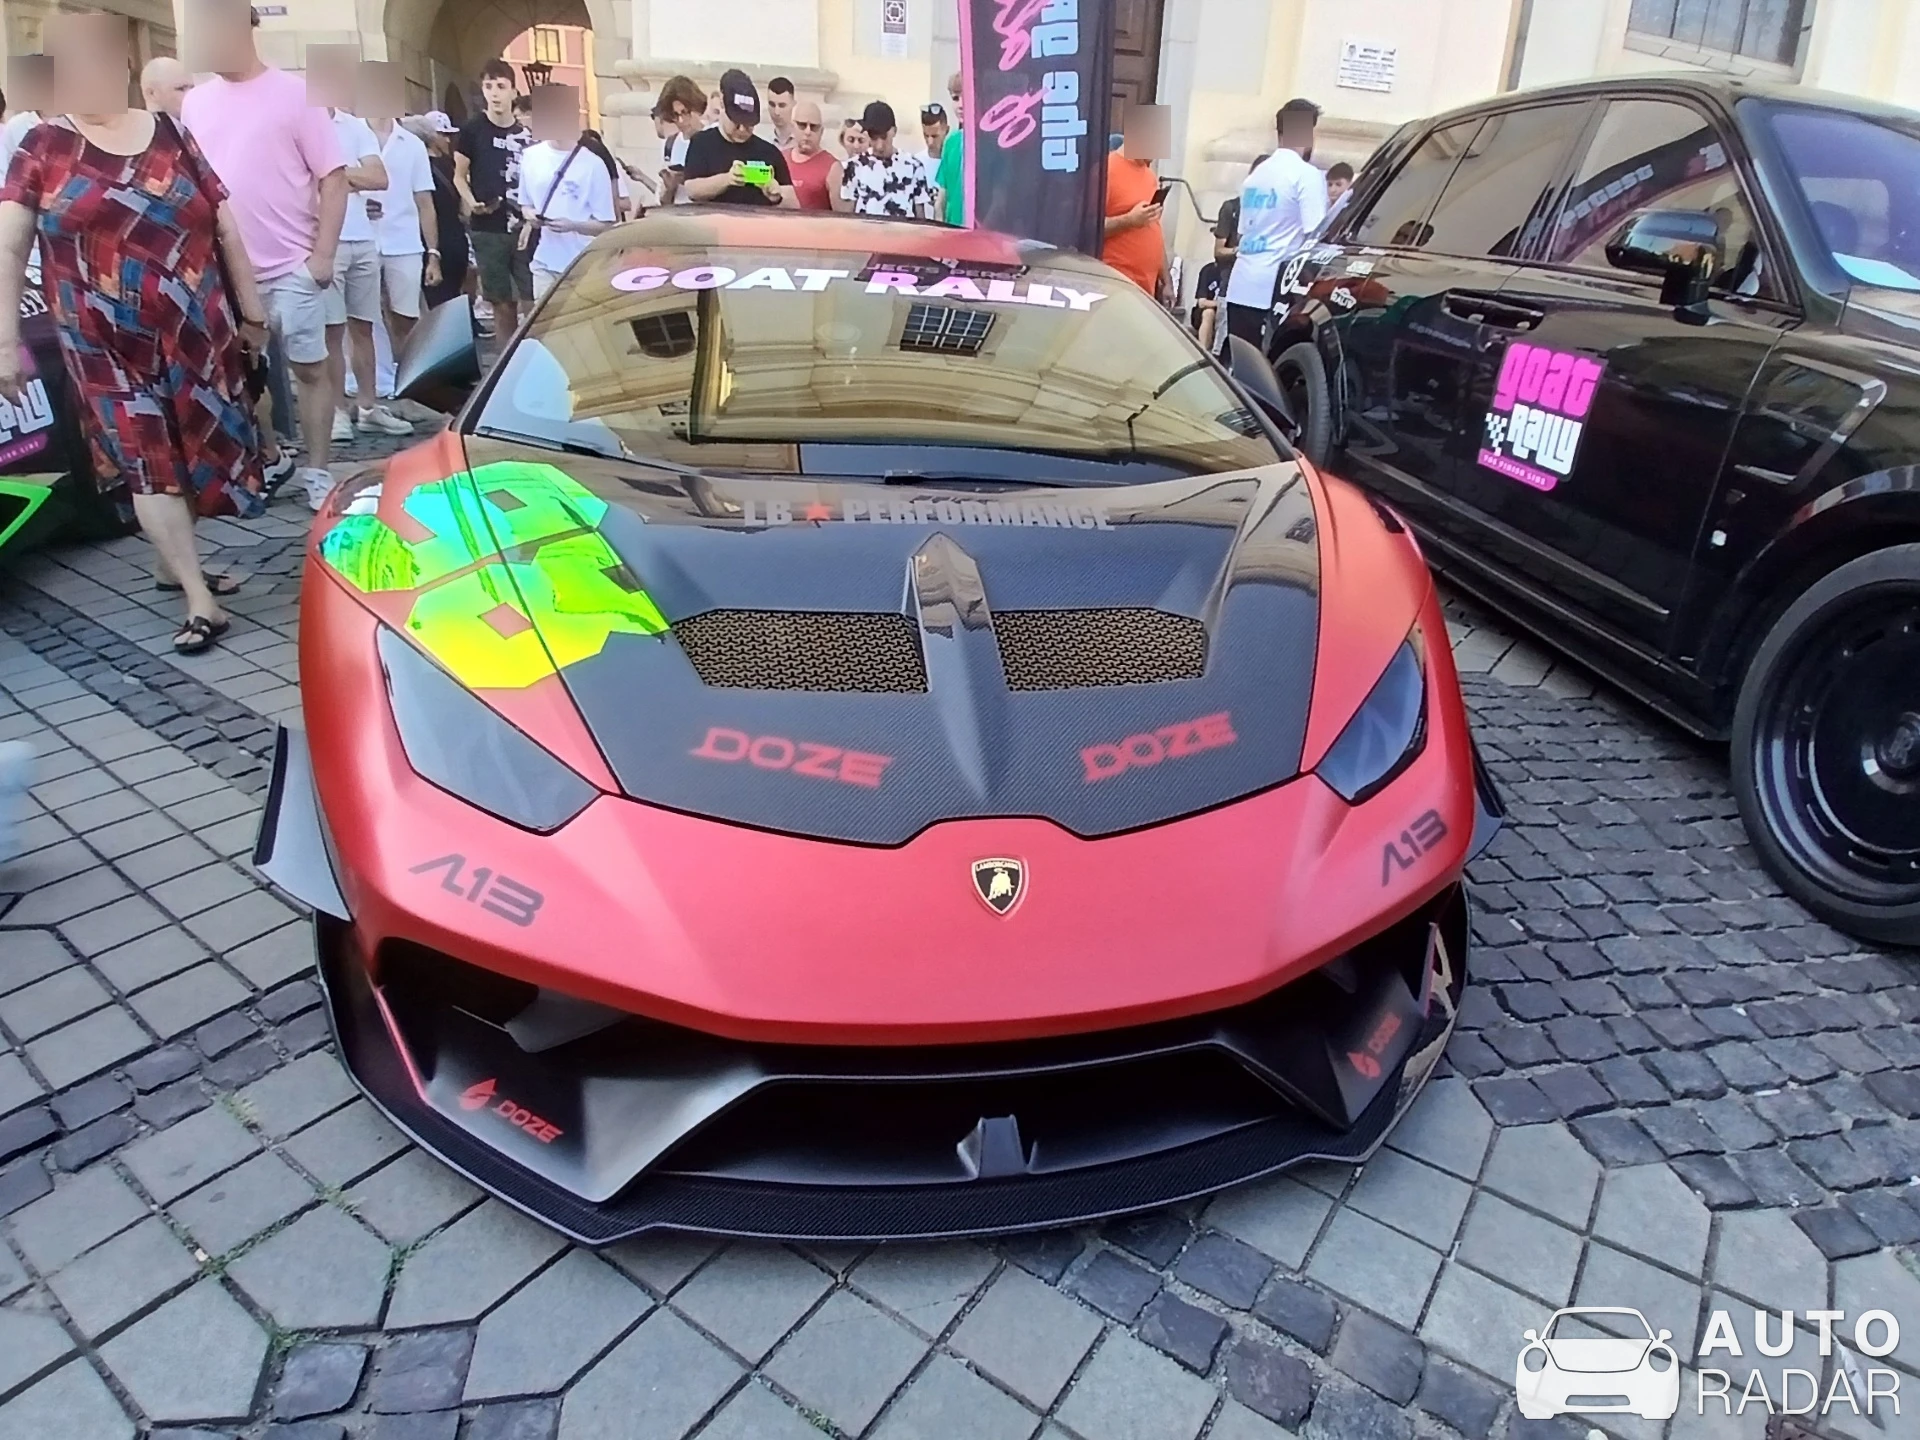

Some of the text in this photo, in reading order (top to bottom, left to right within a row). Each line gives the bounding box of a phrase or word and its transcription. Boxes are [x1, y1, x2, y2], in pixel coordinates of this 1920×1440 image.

[611, 266, 1108, 312] GOAT RALLY
[0, 379, 54, 444] ally
[1494, 343, 1602, 417] goat
[1507, 403, 1583, 475] Rally
[744, 499, 1116, 532] LB PERFORMANCE
[689, 727, 893, 788] DOZE
[1080, 711, 1237, 784] DOZE
[492, 1100, 564, 1143] DOZE
